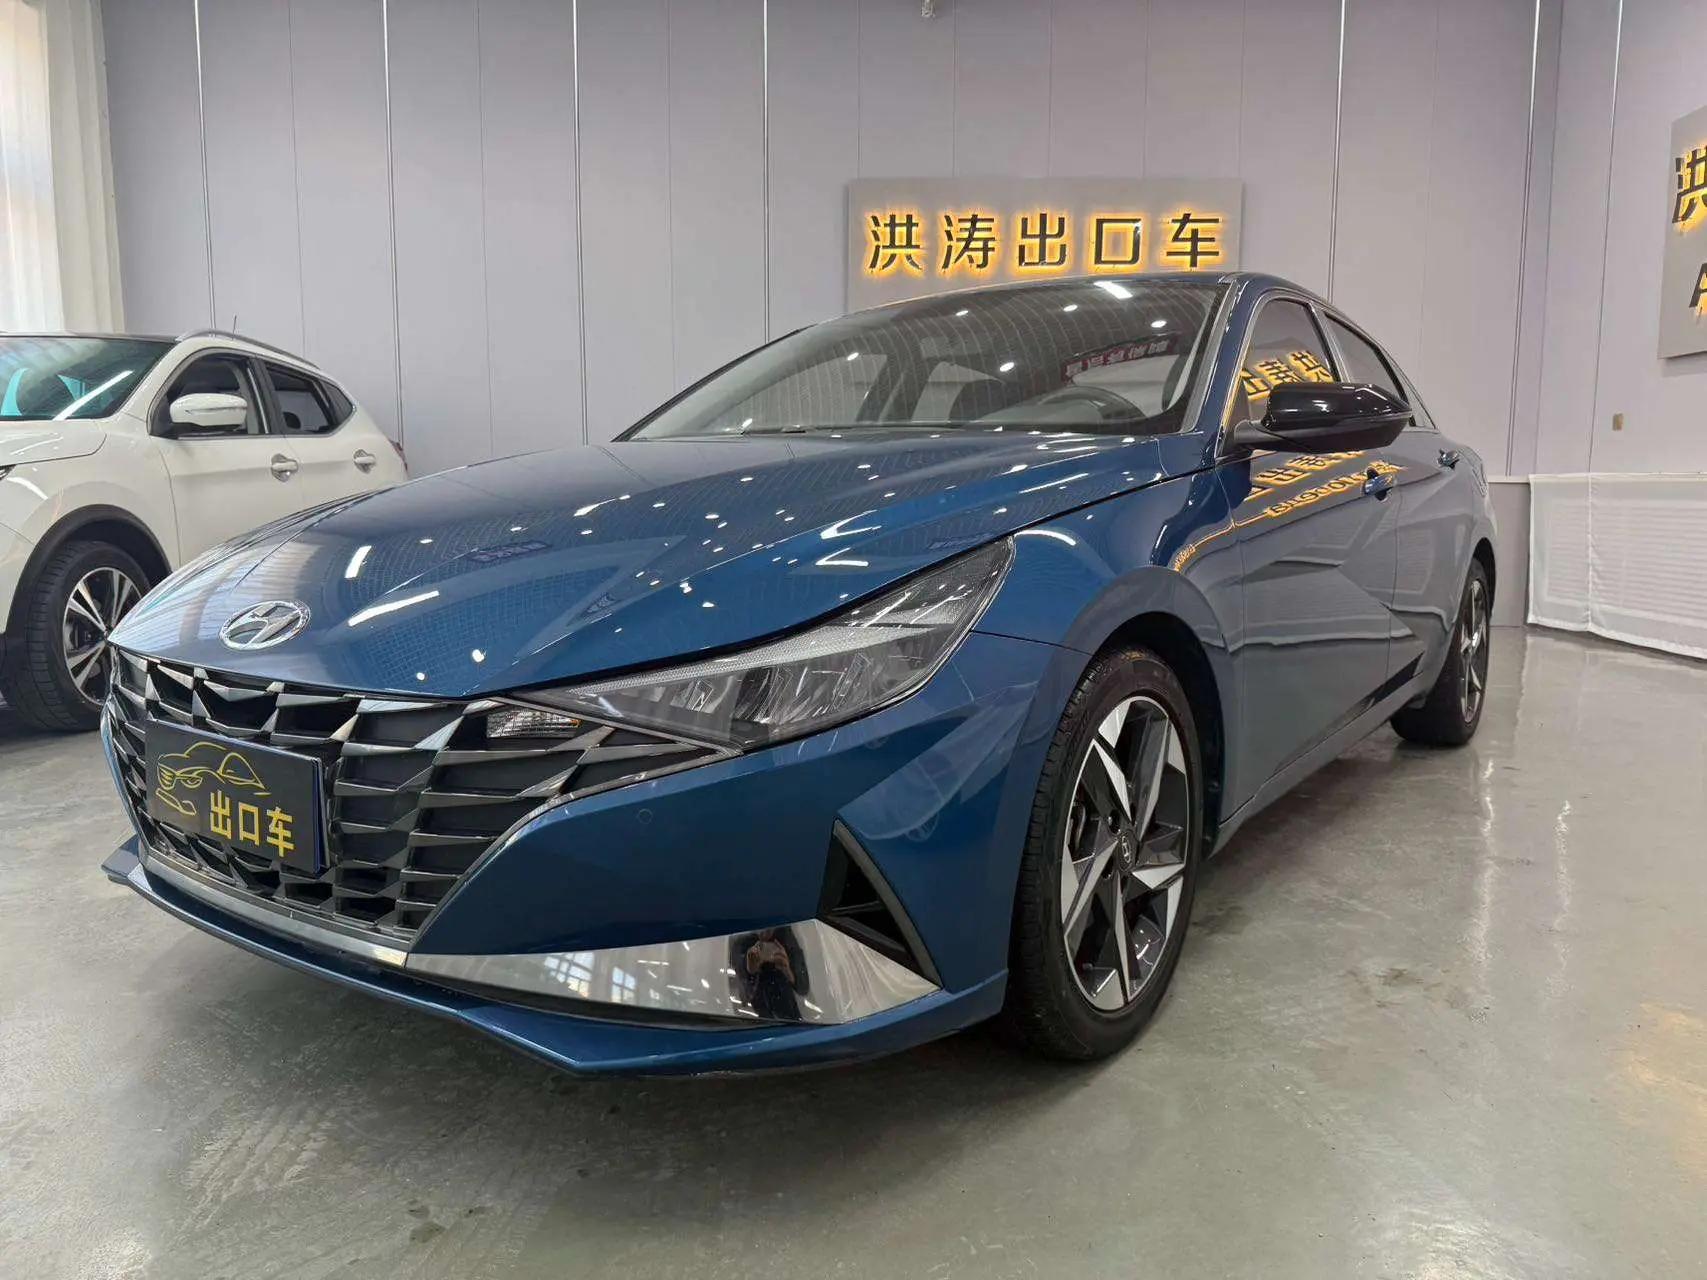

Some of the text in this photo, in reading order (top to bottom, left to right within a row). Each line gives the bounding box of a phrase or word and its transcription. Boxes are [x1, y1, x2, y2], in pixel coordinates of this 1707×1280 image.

[867, 212, 1220, 269] 洪涛出口车
[209, 789, 294, 857] 出口车
